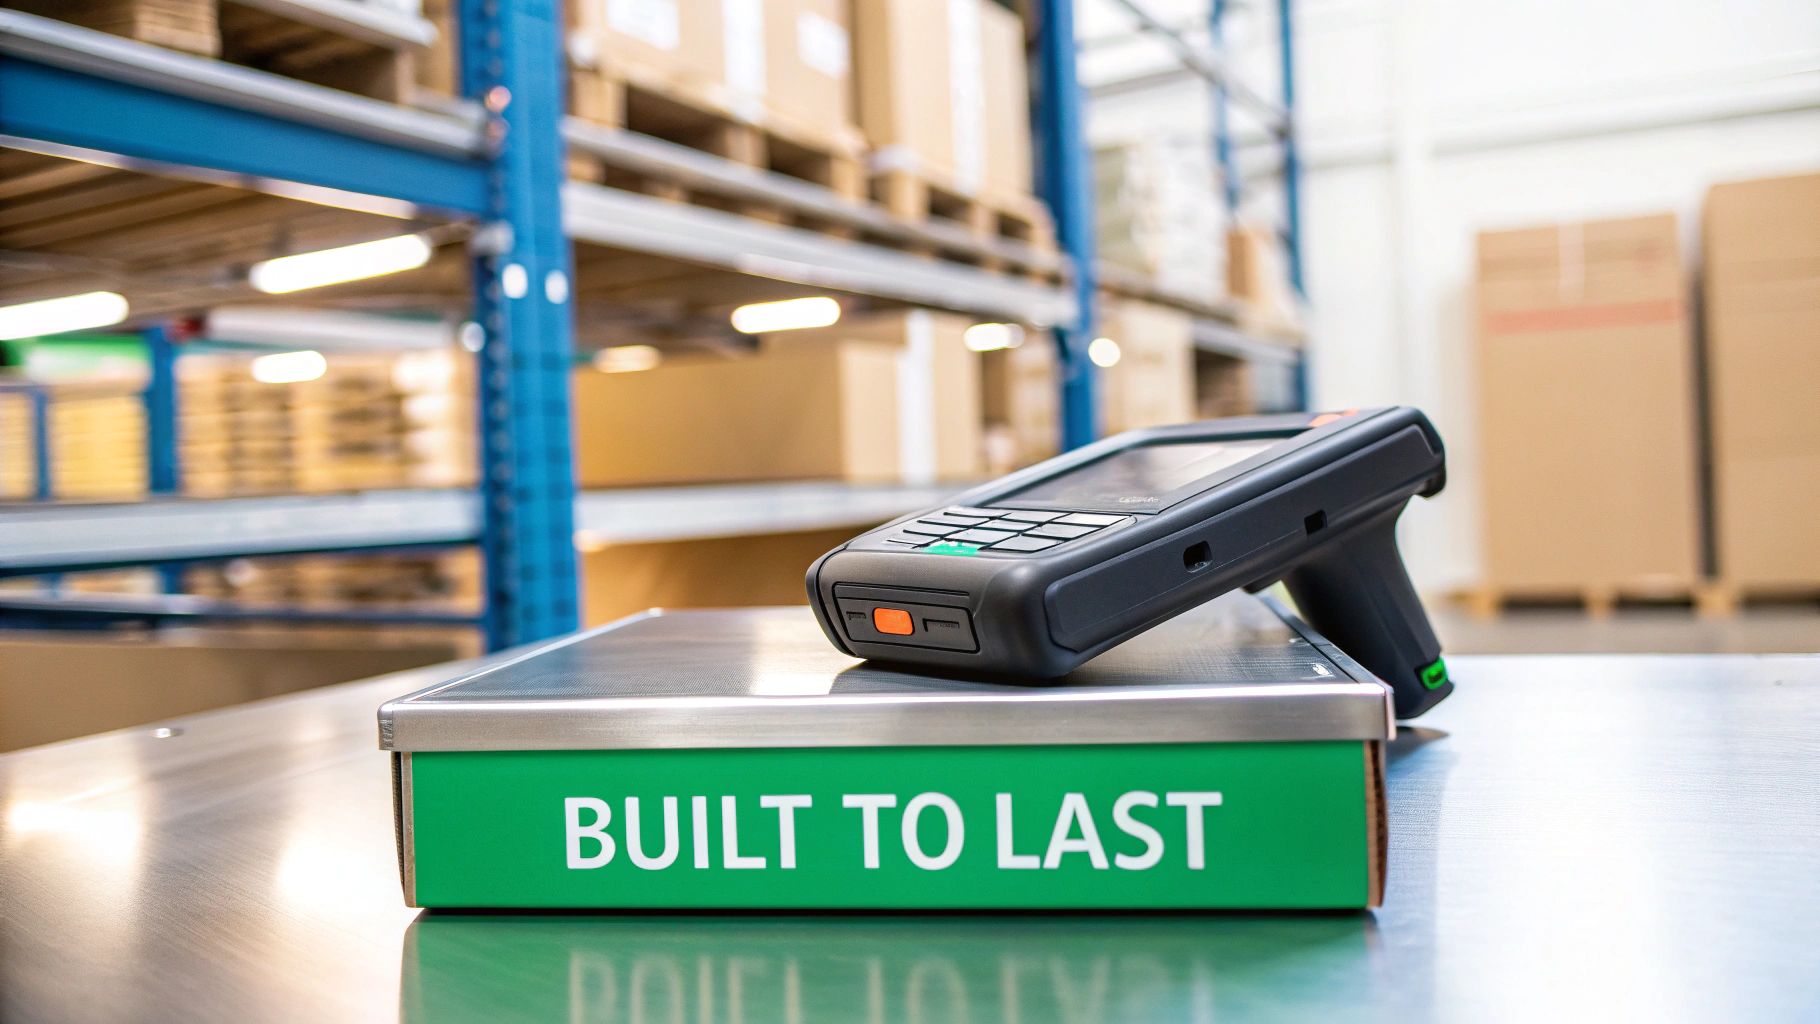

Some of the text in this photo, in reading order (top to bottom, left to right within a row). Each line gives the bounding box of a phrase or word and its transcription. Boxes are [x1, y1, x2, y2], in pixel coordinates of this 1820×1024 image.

[564, 790, 1223, 871] BUILT TO LAST
